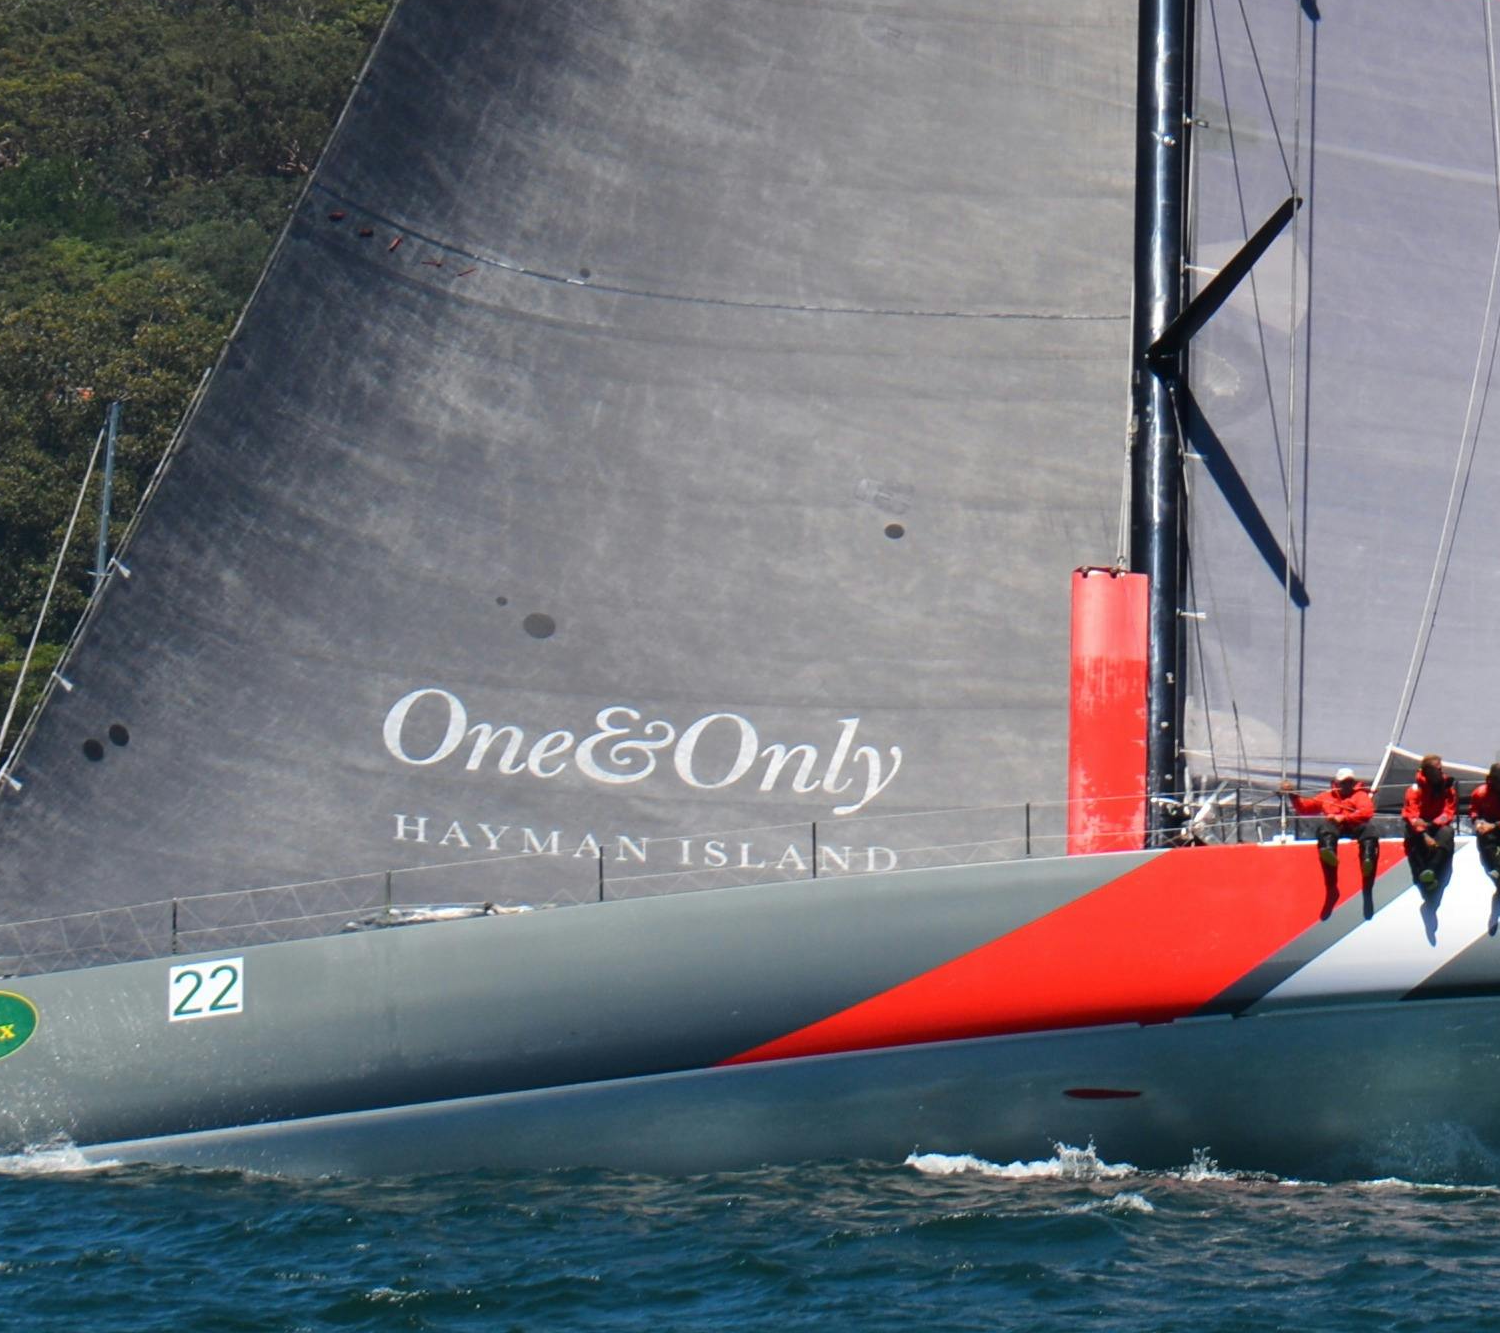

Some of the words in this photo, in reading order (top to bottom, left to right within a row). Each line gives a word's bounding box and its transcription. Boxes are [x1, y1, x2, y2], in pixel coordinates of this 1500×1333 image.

[382, 687, 903, 816] One&Only
[393, 812, 649, 864] HAYMAN
[679, 838, 898, 872] ISLAND
[173, 964, 239, 1017] 22
